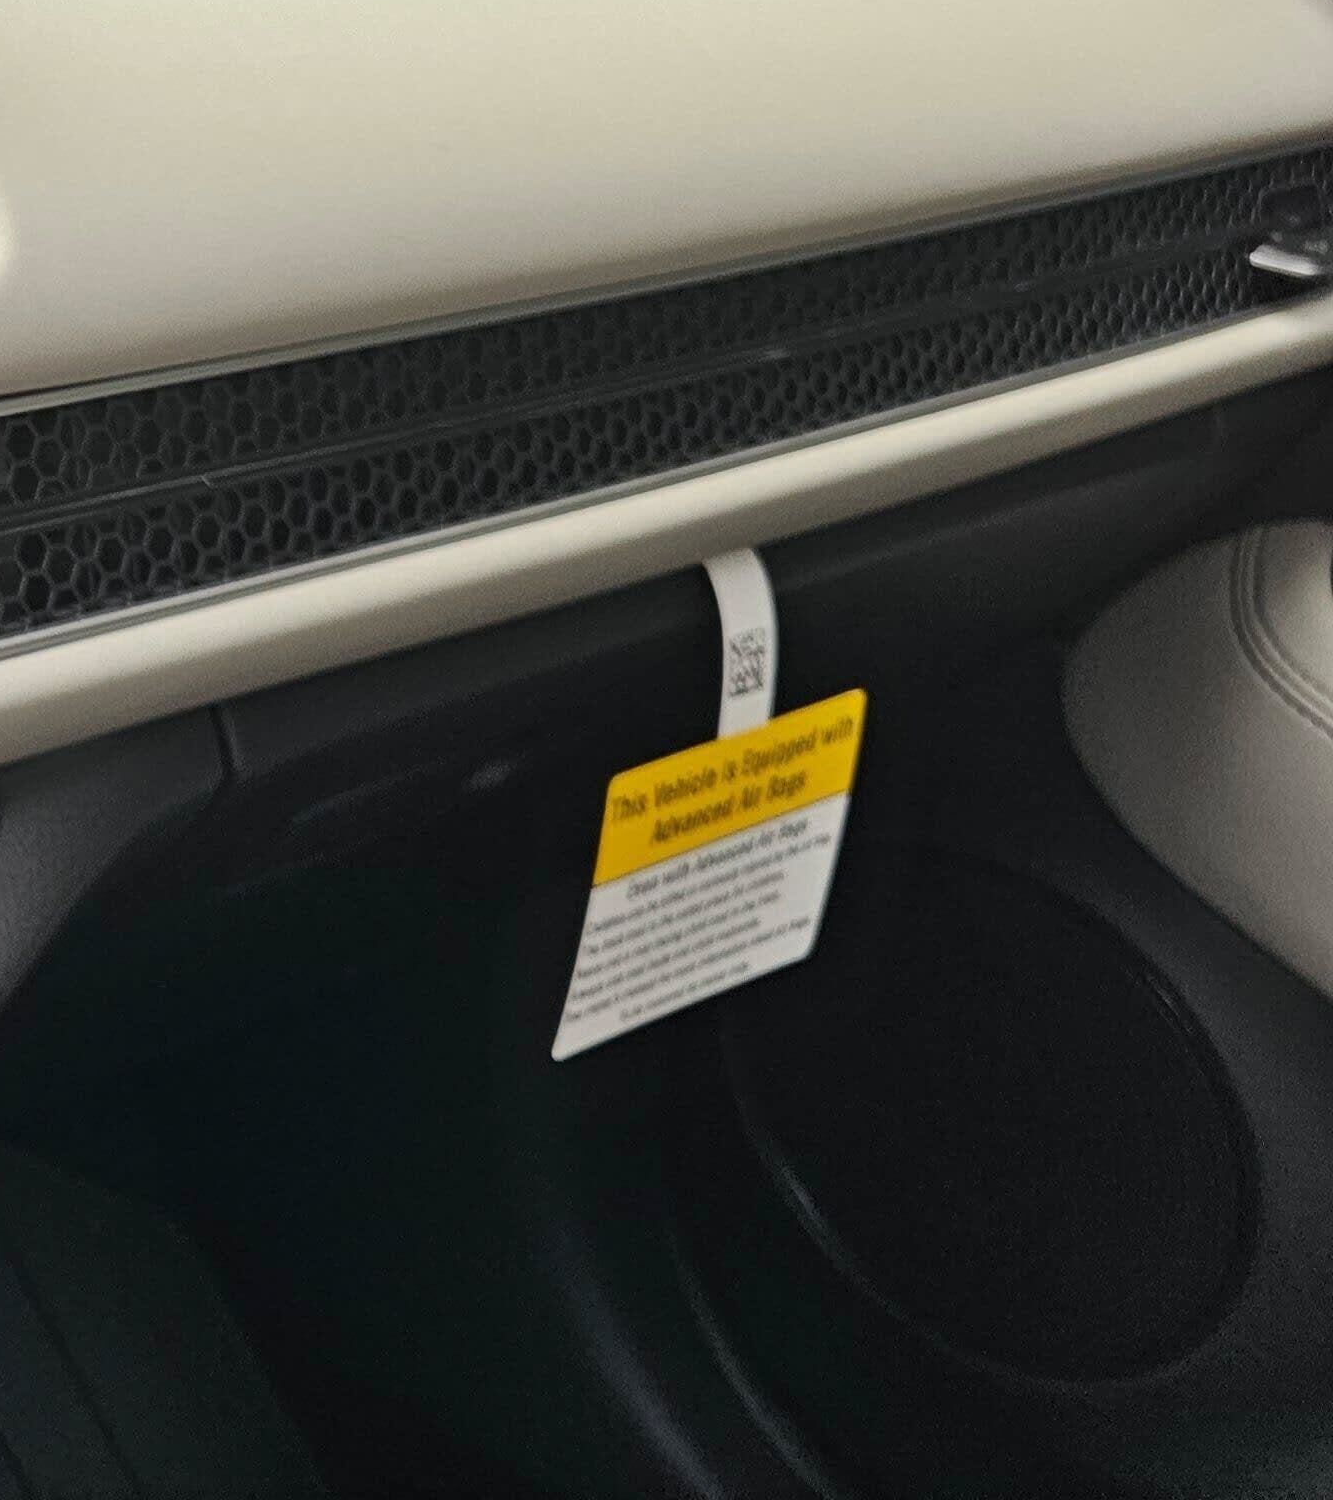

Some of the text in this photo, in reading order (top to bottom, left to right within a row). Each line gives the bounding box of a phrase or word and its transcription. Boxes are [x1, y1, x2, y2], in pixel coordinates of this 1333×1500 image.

[612, 792, 648, 820] This
[653, 766, 718, 808] Vehicle
[741, 726, 818, 776] Equipped
[821, 716, 854, 745] with
[650, 794, 734, 844] Advanced
